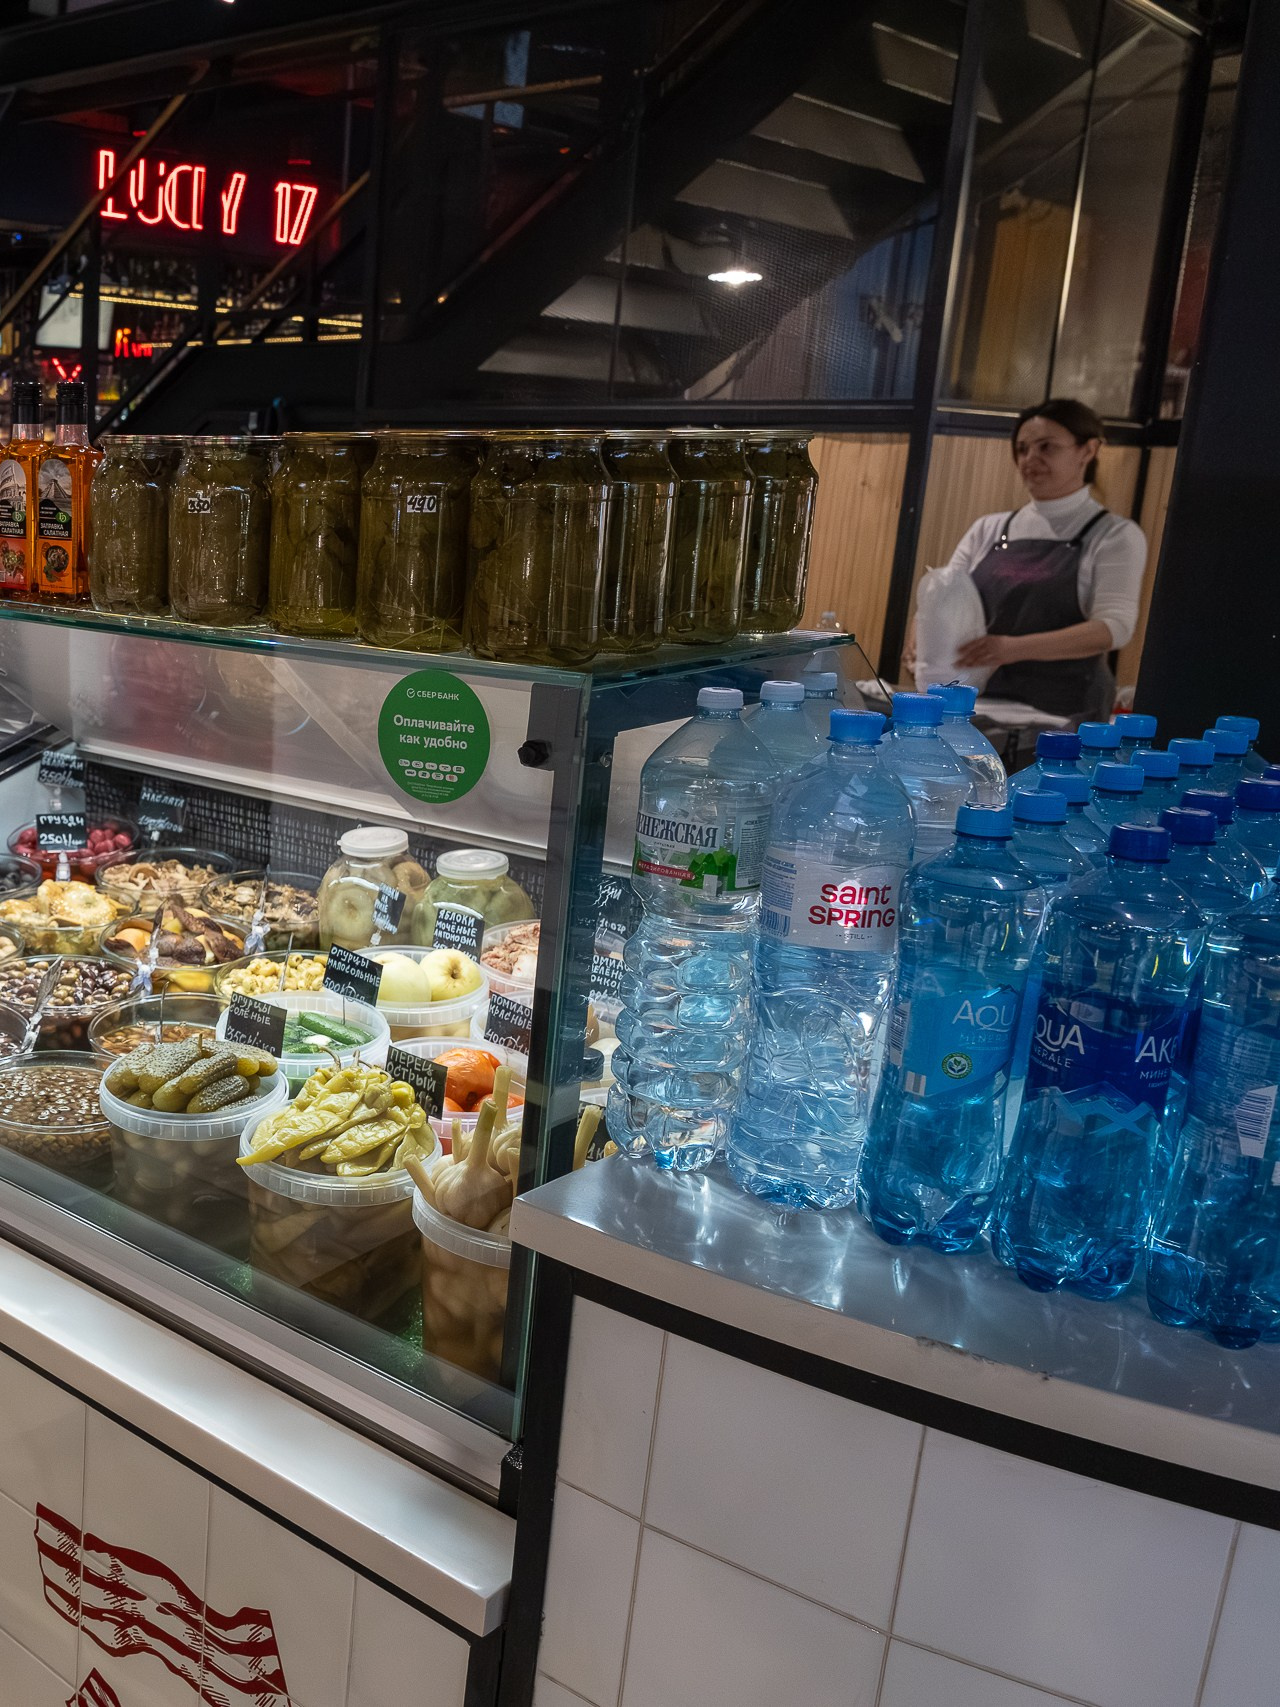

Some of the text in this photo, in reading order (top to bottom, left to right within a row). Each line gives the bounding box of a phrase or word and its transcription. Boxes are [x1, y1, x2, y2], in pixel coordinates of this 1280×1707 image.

[274, 182, 318, 245] 17
[416, 690, 460, 701] СБЕРБАНК
[393, 714, 475, 734] Оплачивайте
[399, 734, 468, 750] как удобно
[436, 920, 478, 938] МОЧЁНЫЕ
[438, 909, 476, 927] ЯБЛОКИ
[433, 928, 477, 948] АНТОНОВКА
[331, 945, 370, 968] ОГУРЦЫ
[327, 958, 381, 988] МАЛОСОЛЬНЫЕ
[231, 993, 271, 1014] ОГУРЦЫ
[489, 1004, 532, 1031] КРАСНЫЕ
[951, 1000, 1017, 1032] AQU
[1034, 1013, 1085, 1055] QUA
[390, 1049, 434, 1075] ПЕРЕЦ
[386, 1062, 436, 1092] ОСТРЫЙ
